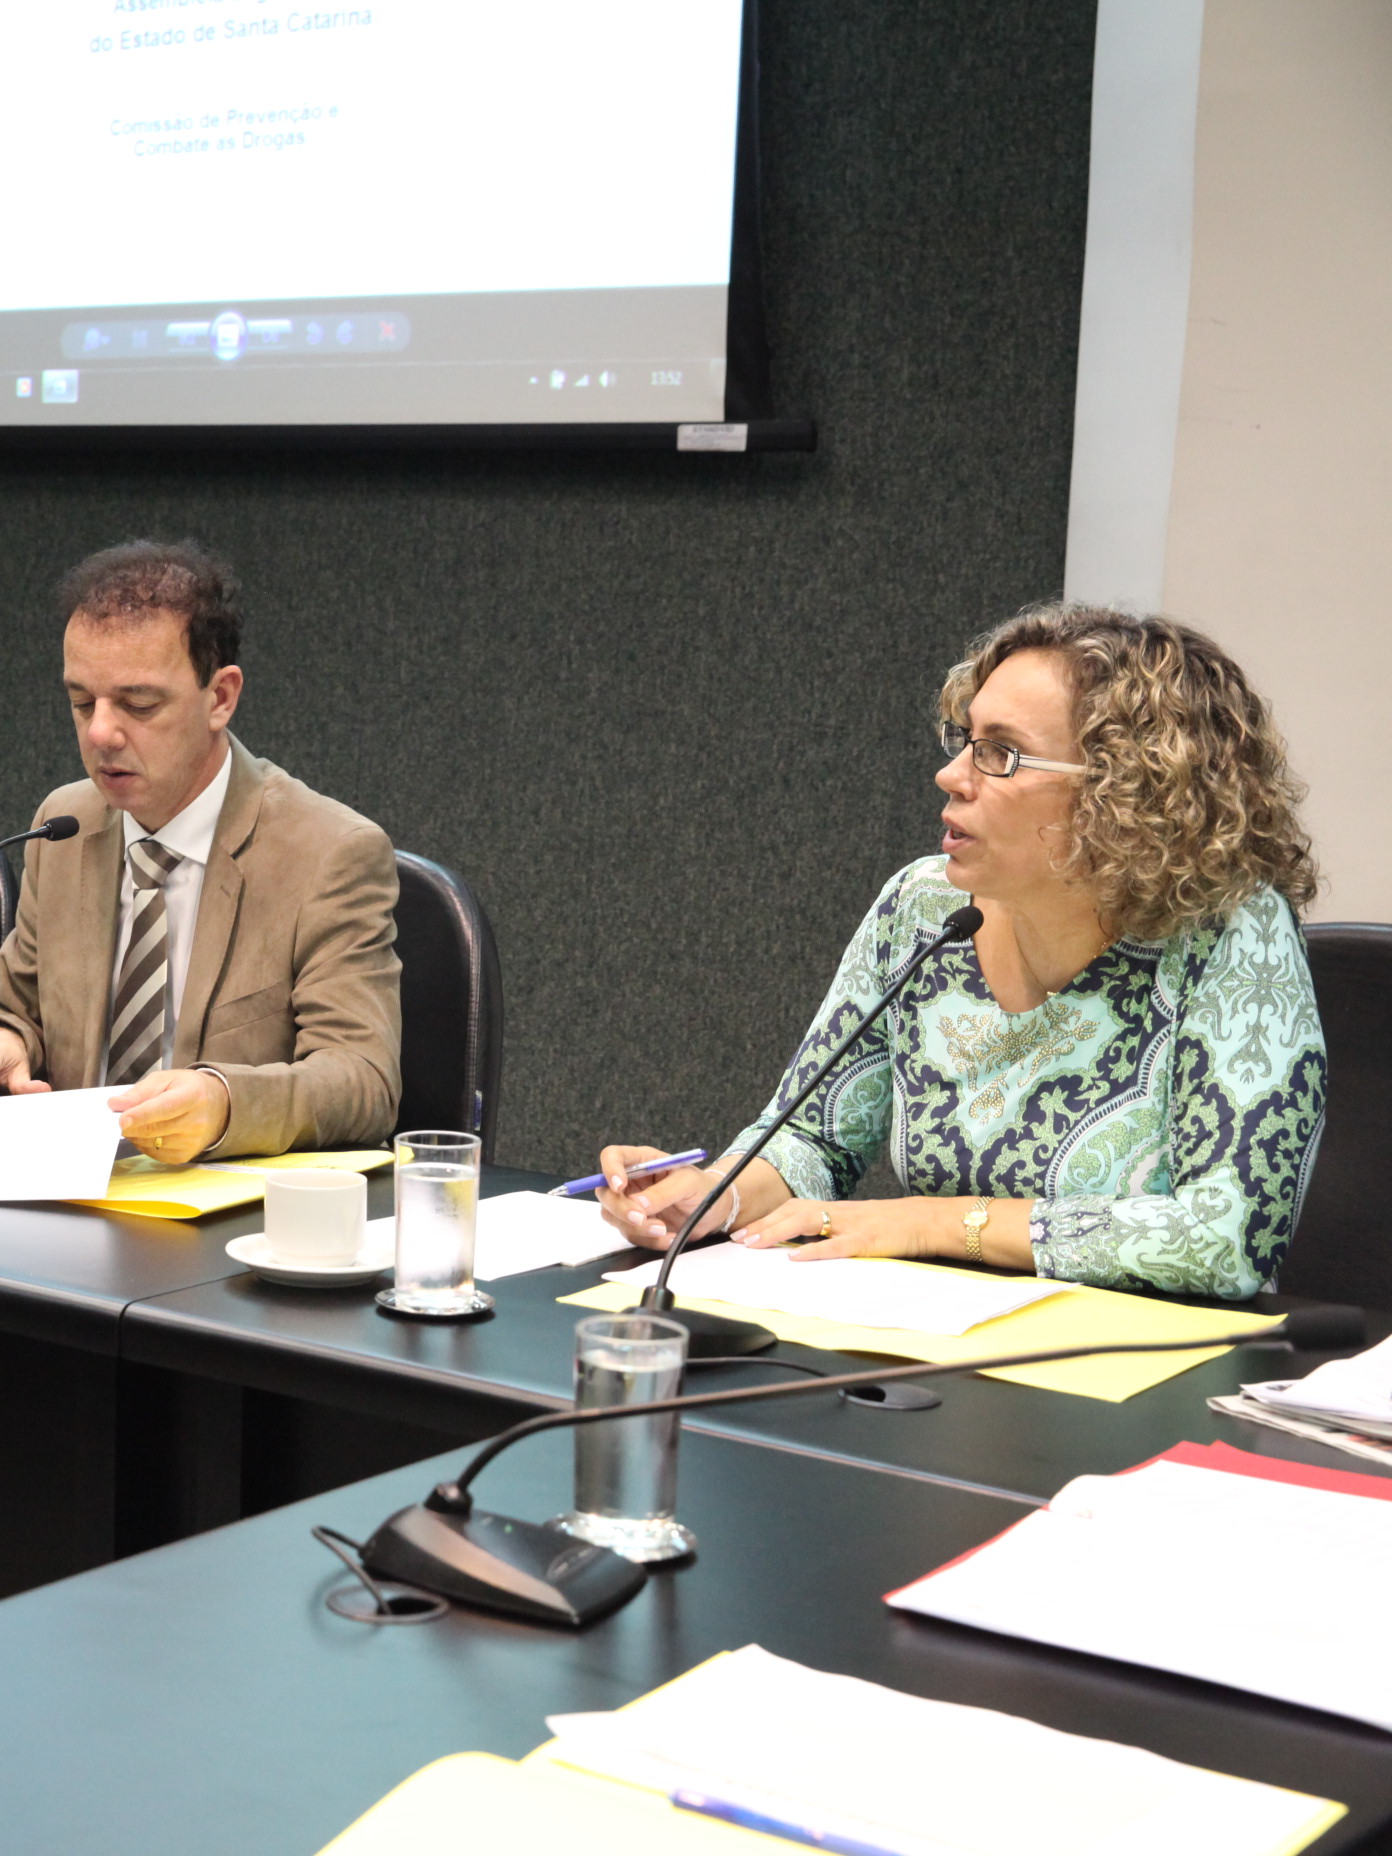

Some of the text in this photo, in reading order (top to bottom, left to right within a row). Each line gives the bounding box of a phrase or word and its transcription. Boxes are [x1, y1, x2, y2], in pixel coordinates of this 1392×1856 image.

[90, 8, 373, 53] do Estado de Santa Catarina
[200, 113, 220, 129] de
[134, 138, 210, 157] Combate
[242, 129, 306, 151] Drogas
